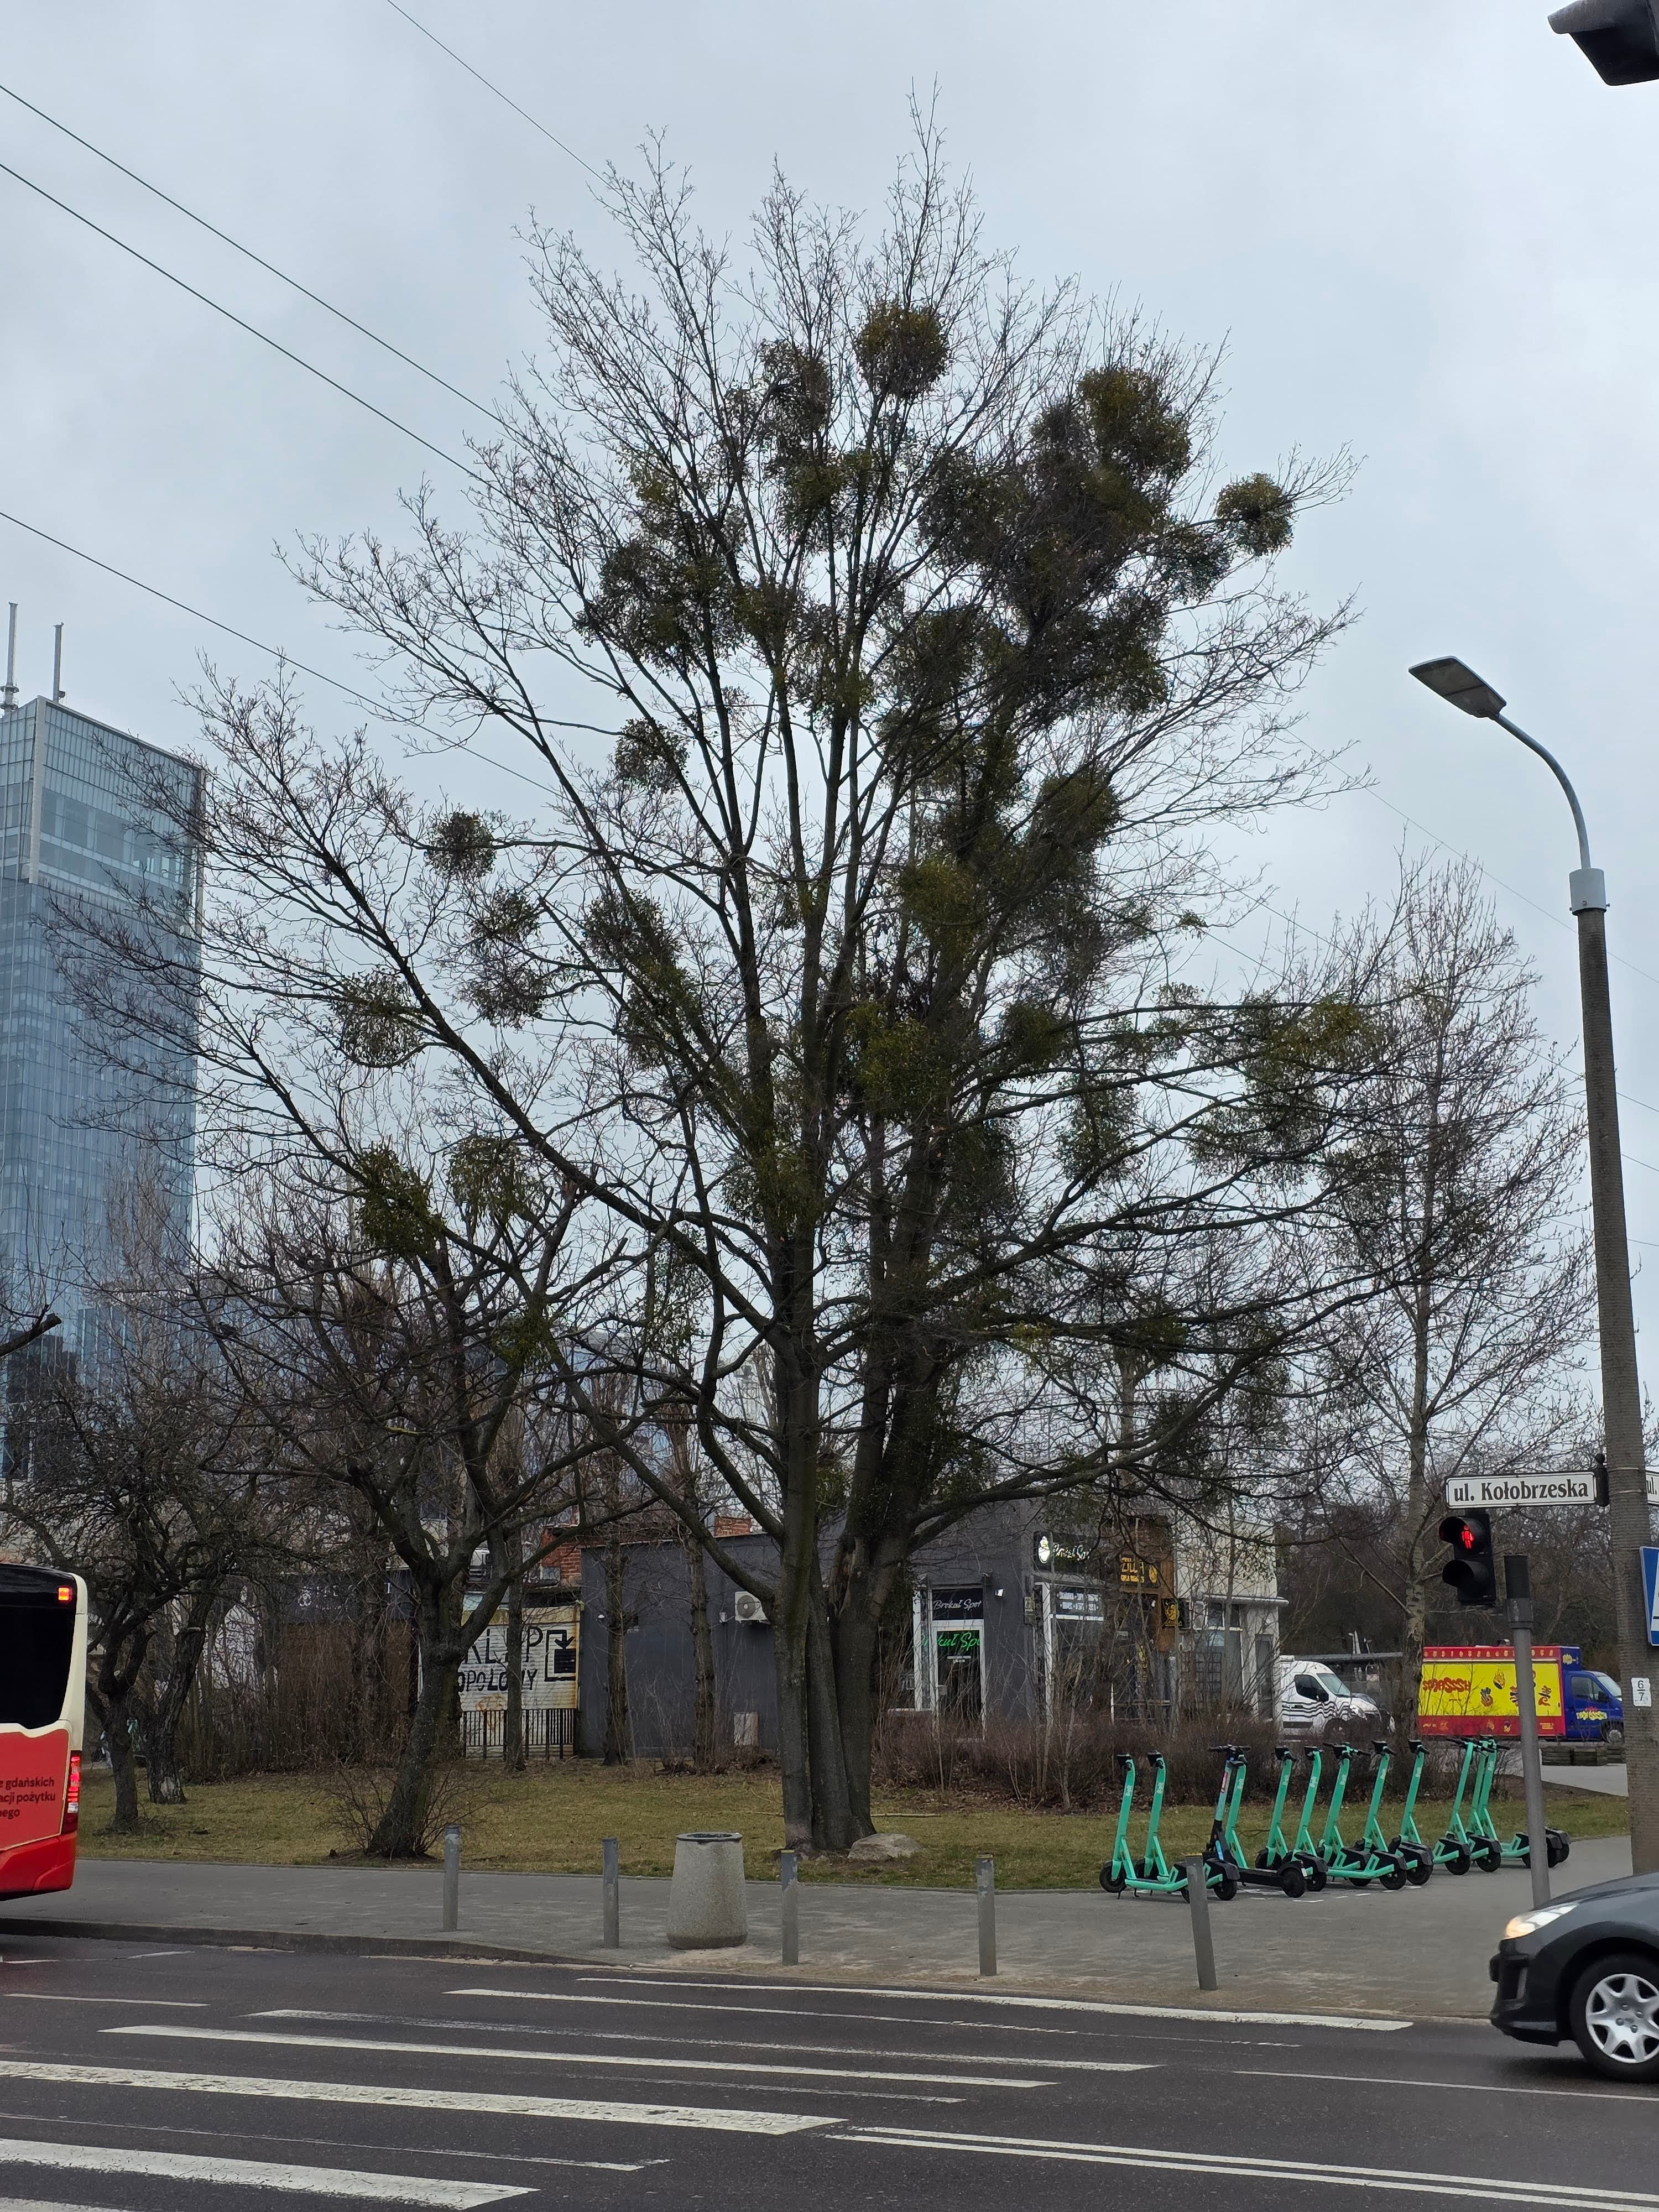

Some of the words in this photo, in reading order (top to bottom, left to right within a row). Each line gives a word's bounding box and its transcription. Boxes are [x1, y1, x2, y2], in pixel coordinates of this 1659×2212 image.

[1454, 1483, 1475, 1502] ul.
[1481, 1479, 1589, 1501] Kołobrzeska
[963, 1598, 982, 1610] Spot
[1638, 1680, 1644, 1689] 6
[1639, 1692, 1645, 1702] 7
[6, 1777, 55, 1790] gdańskich
[16, 1791, 56, 1804] pożytku
